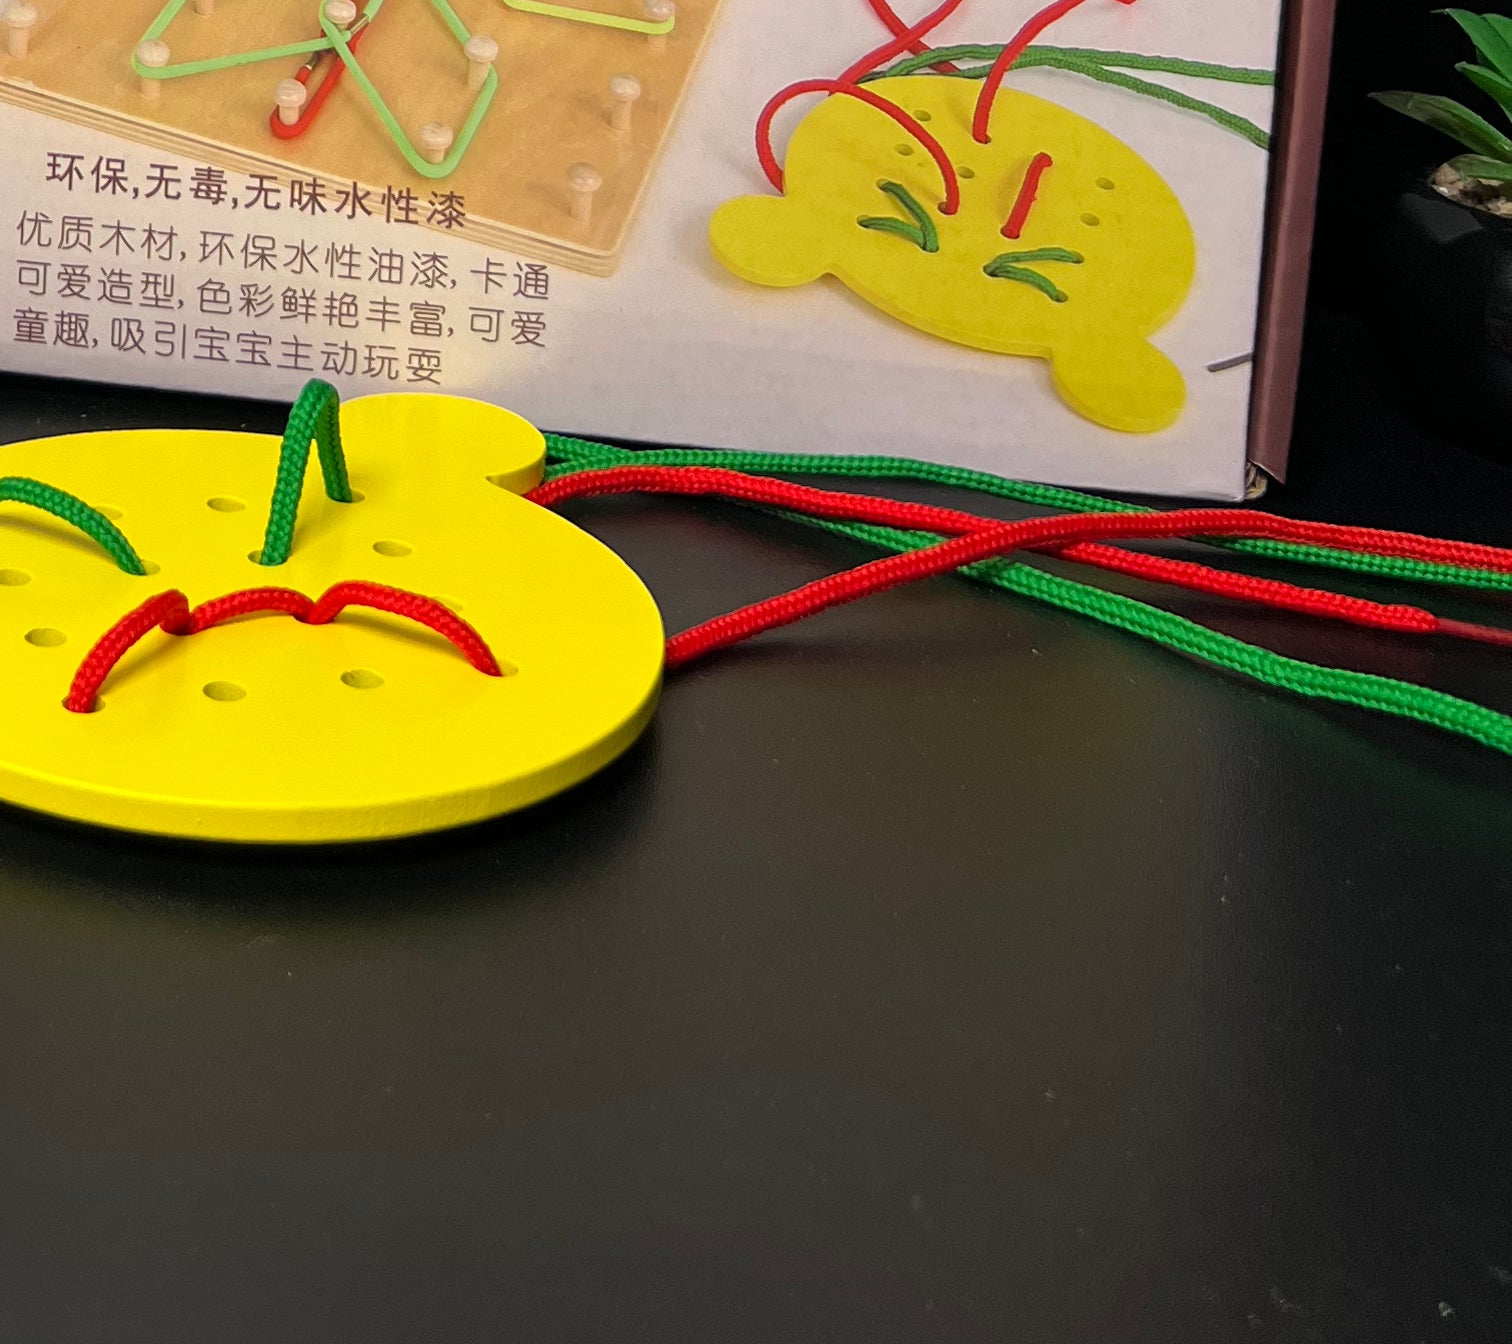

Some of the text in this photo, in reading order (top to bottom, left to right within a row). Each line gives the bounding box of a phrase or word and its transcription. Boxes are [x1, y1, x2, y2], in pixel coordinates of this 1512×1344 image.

[45, 152, 466, 229] 环保,无毒,无味水性漆
